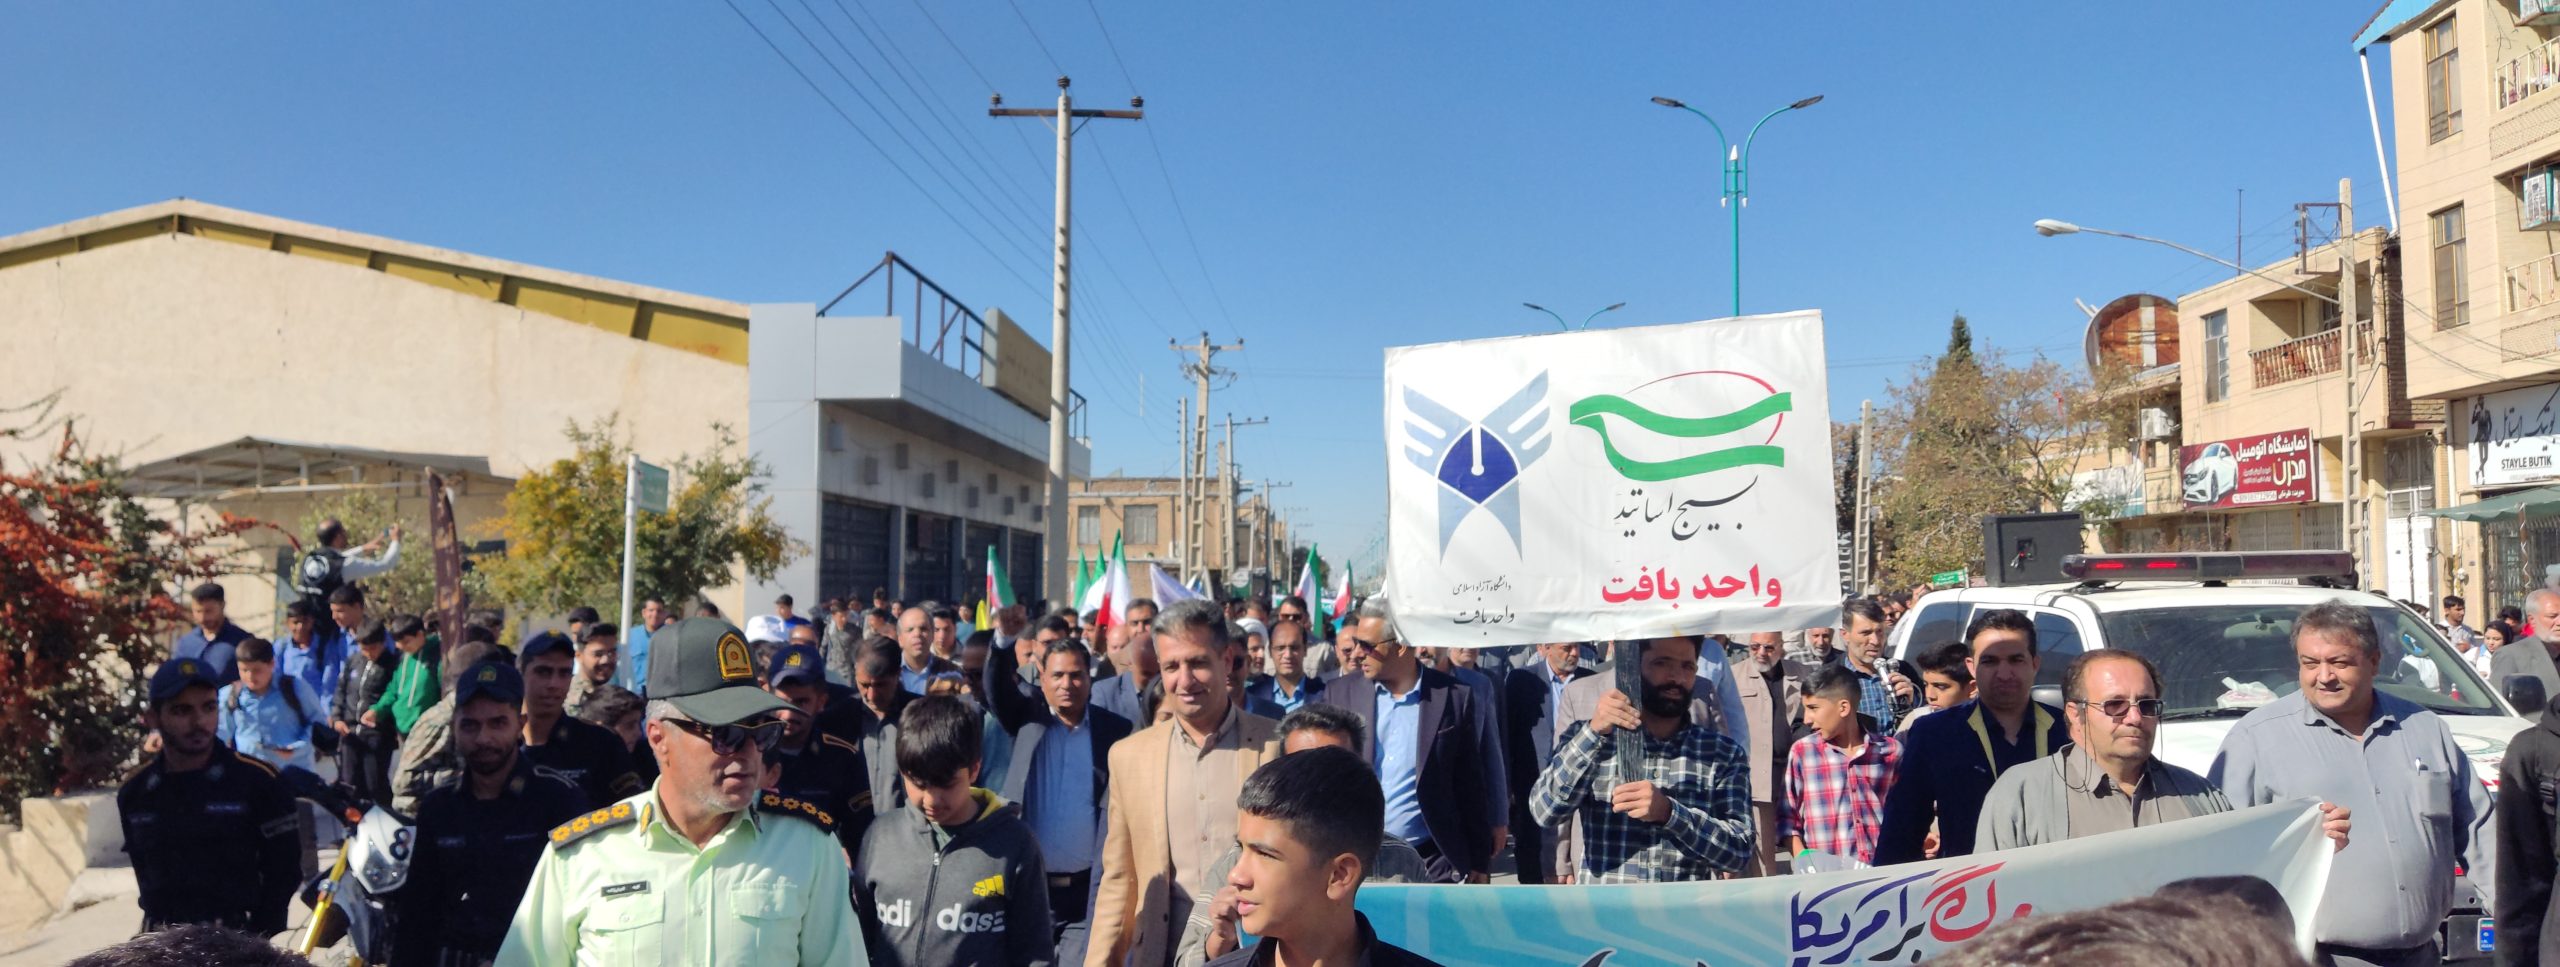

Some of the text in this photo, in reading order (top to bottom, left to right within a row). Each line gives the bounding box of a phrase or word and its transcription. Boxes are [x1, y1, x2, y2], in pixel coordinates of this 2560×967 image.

[2495, 407, 2523, 449] استایل
[2235, 434, 2307, 462] نمایشگاه اتومبیل
[2501, 455, 2552, 469] STAYLE BUTIK
[2272, 457, 2307, 487] مدرن
[1613, 474, 1759, 541] بسیج اساتید
[1452, 583, 1475, 596] اسلامی
[1489, 574, 1512, 592] دانشگاه
[1601, 563, 1783, 610] واحد بافت
[1453, 597, 1515, 636] واحد بافت
[1867, 921, 1926, 964] بر
